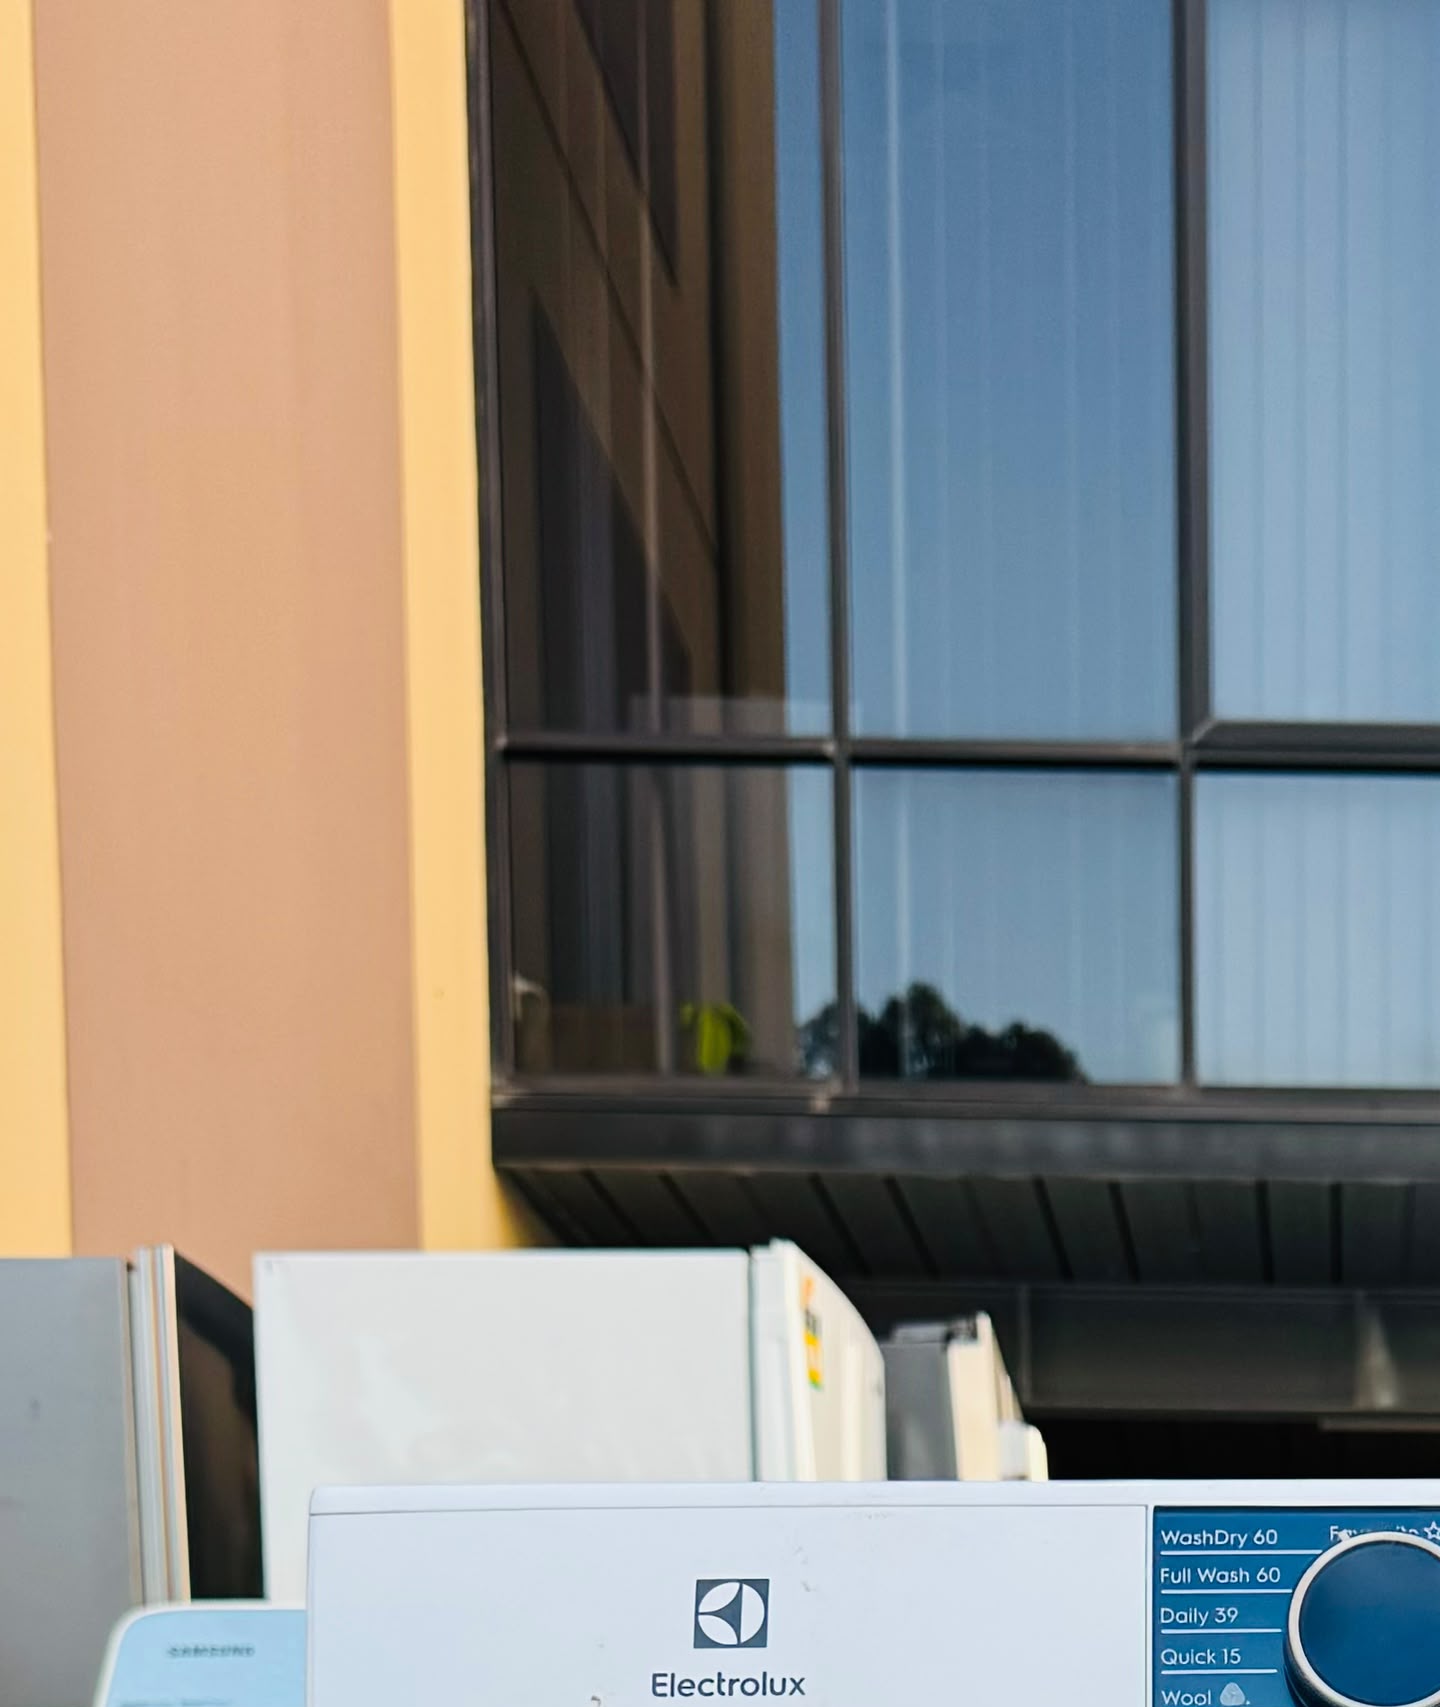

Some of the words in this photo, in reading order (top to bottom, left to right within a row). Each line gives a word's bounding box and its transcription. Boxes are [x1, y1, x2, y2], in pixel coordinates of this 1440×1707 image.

[1161, 1529, 1248, 1548] WashDry
[1252, 1529, 1278, 1545] 60
[1160, 1567, 1194, 1584] Full
[1197, 1567, 1250, 1584] Wash
[1256, 1567, 1281, 1583] 60
[1160, 1607, 1211, 1625] Daily
[1215, 1607, 1238, 1624] 39
[1161, 1648, 1216, 1666] Quick
[1222, 1649, 1241, 1665] 15
[651, 1671, 806, 1698] Electrolux
[1161, 1689, 1211, 1706] Wool
